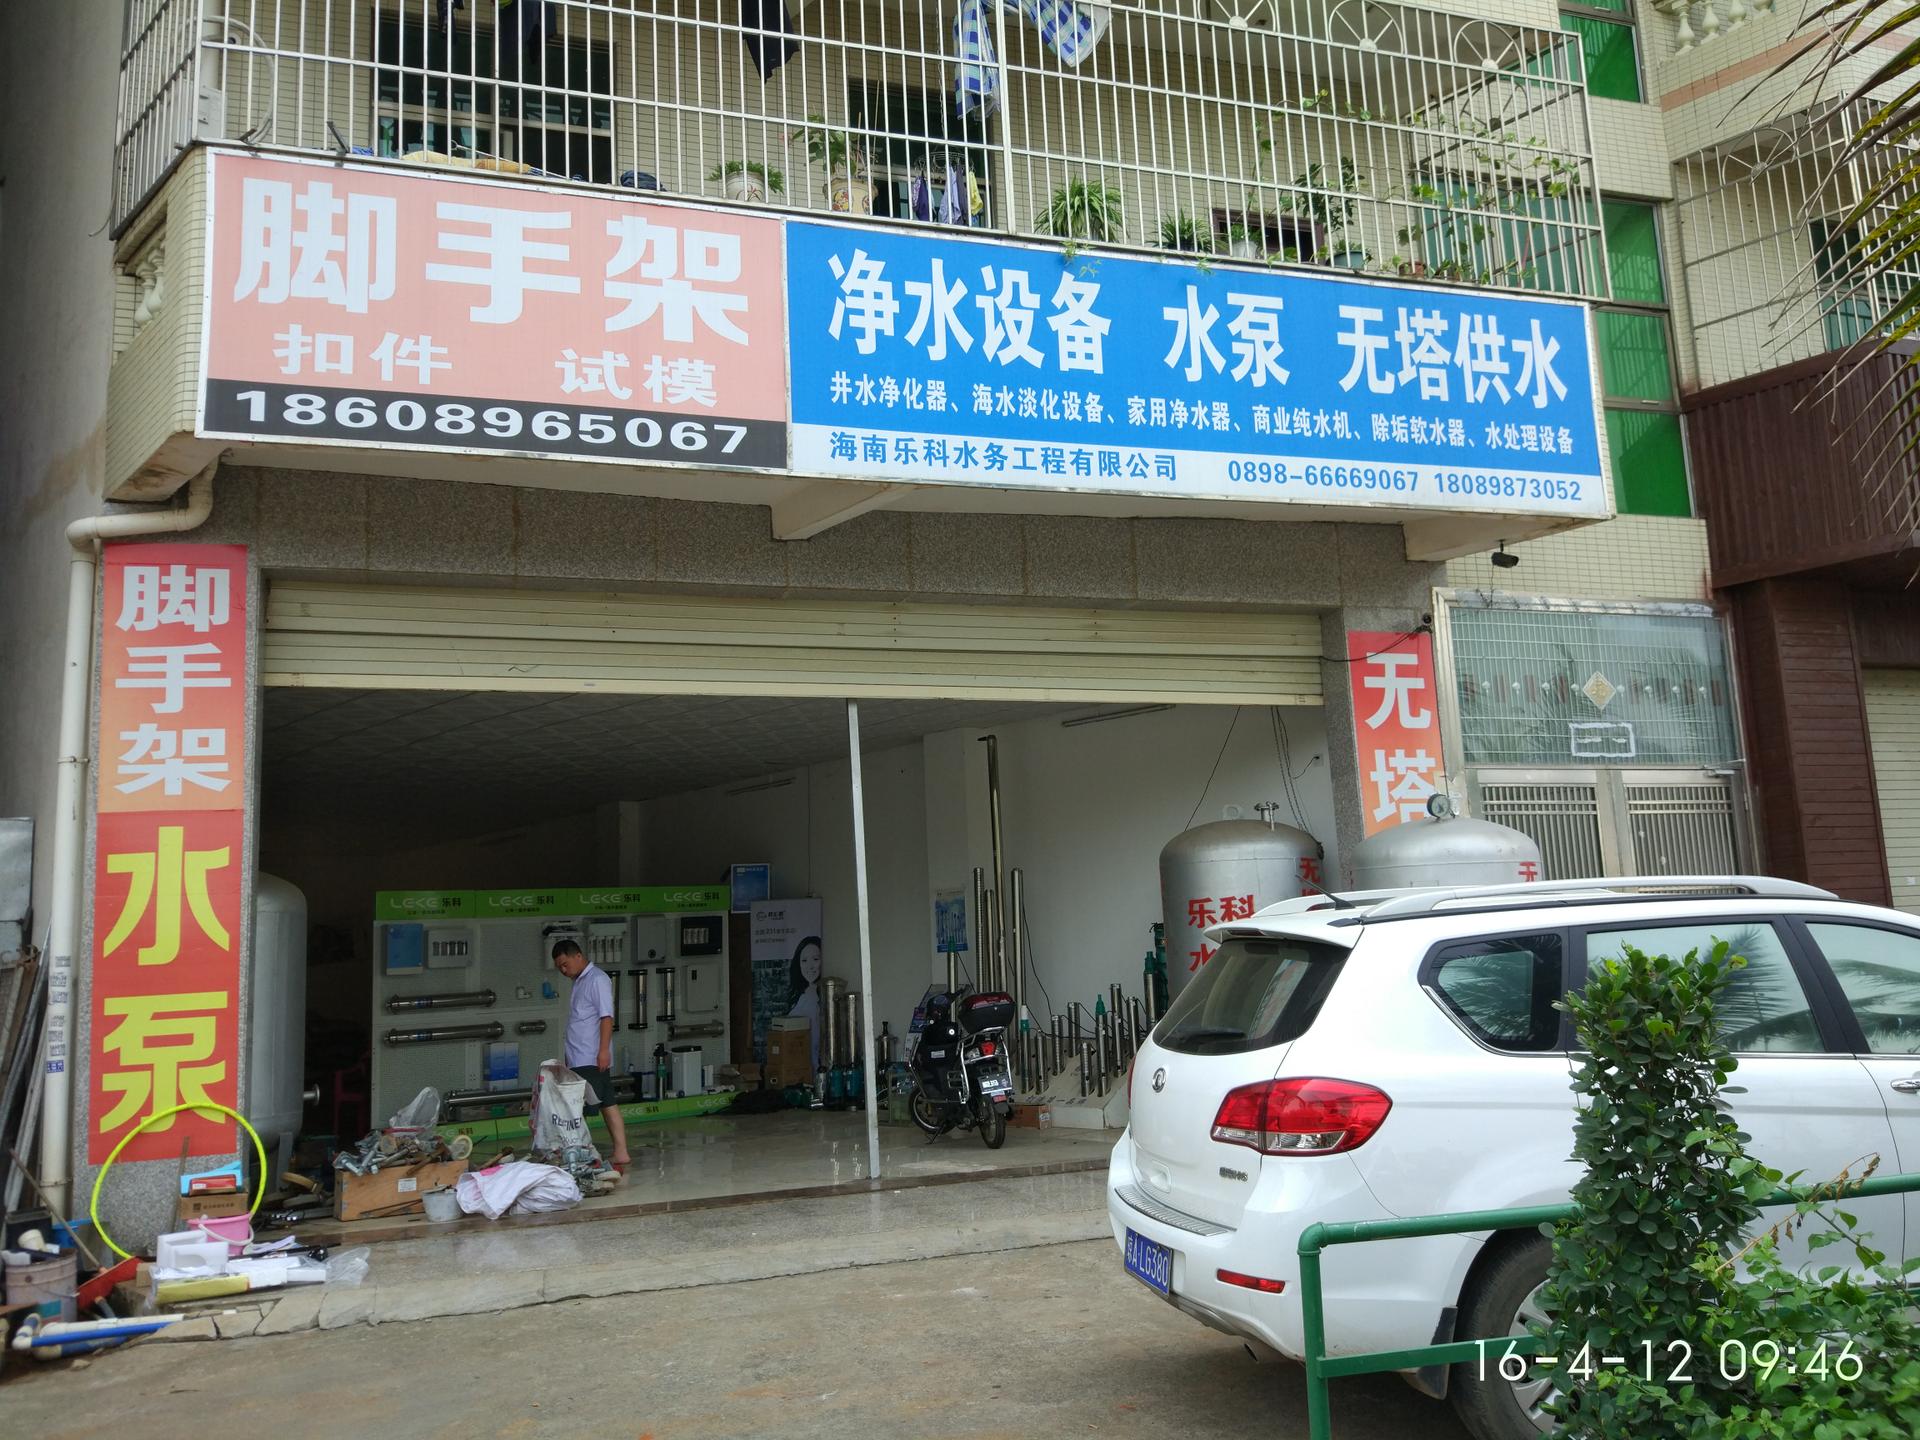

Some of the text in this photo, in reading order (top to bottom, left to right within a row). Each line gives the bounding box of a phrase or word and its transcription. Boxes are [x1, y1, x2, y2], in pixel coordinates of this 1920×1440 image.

[233, 177, 749, 346] 脚手架
[272, 324, 717, 408] 扣件 试模
[827, 248, 1568, 409] 净水设备 水泵 无塔供水
[235, 390, 748, 454] 18608965067
[829, 431, 1582, 502] 海南乐科水务工程有限公司 0898-66669067 18089873052
[114, 565, 232, 795] 脚手架
[1188, 894, 1256, 928] 乐科
[99, 826, 230, 1134] 水泵
